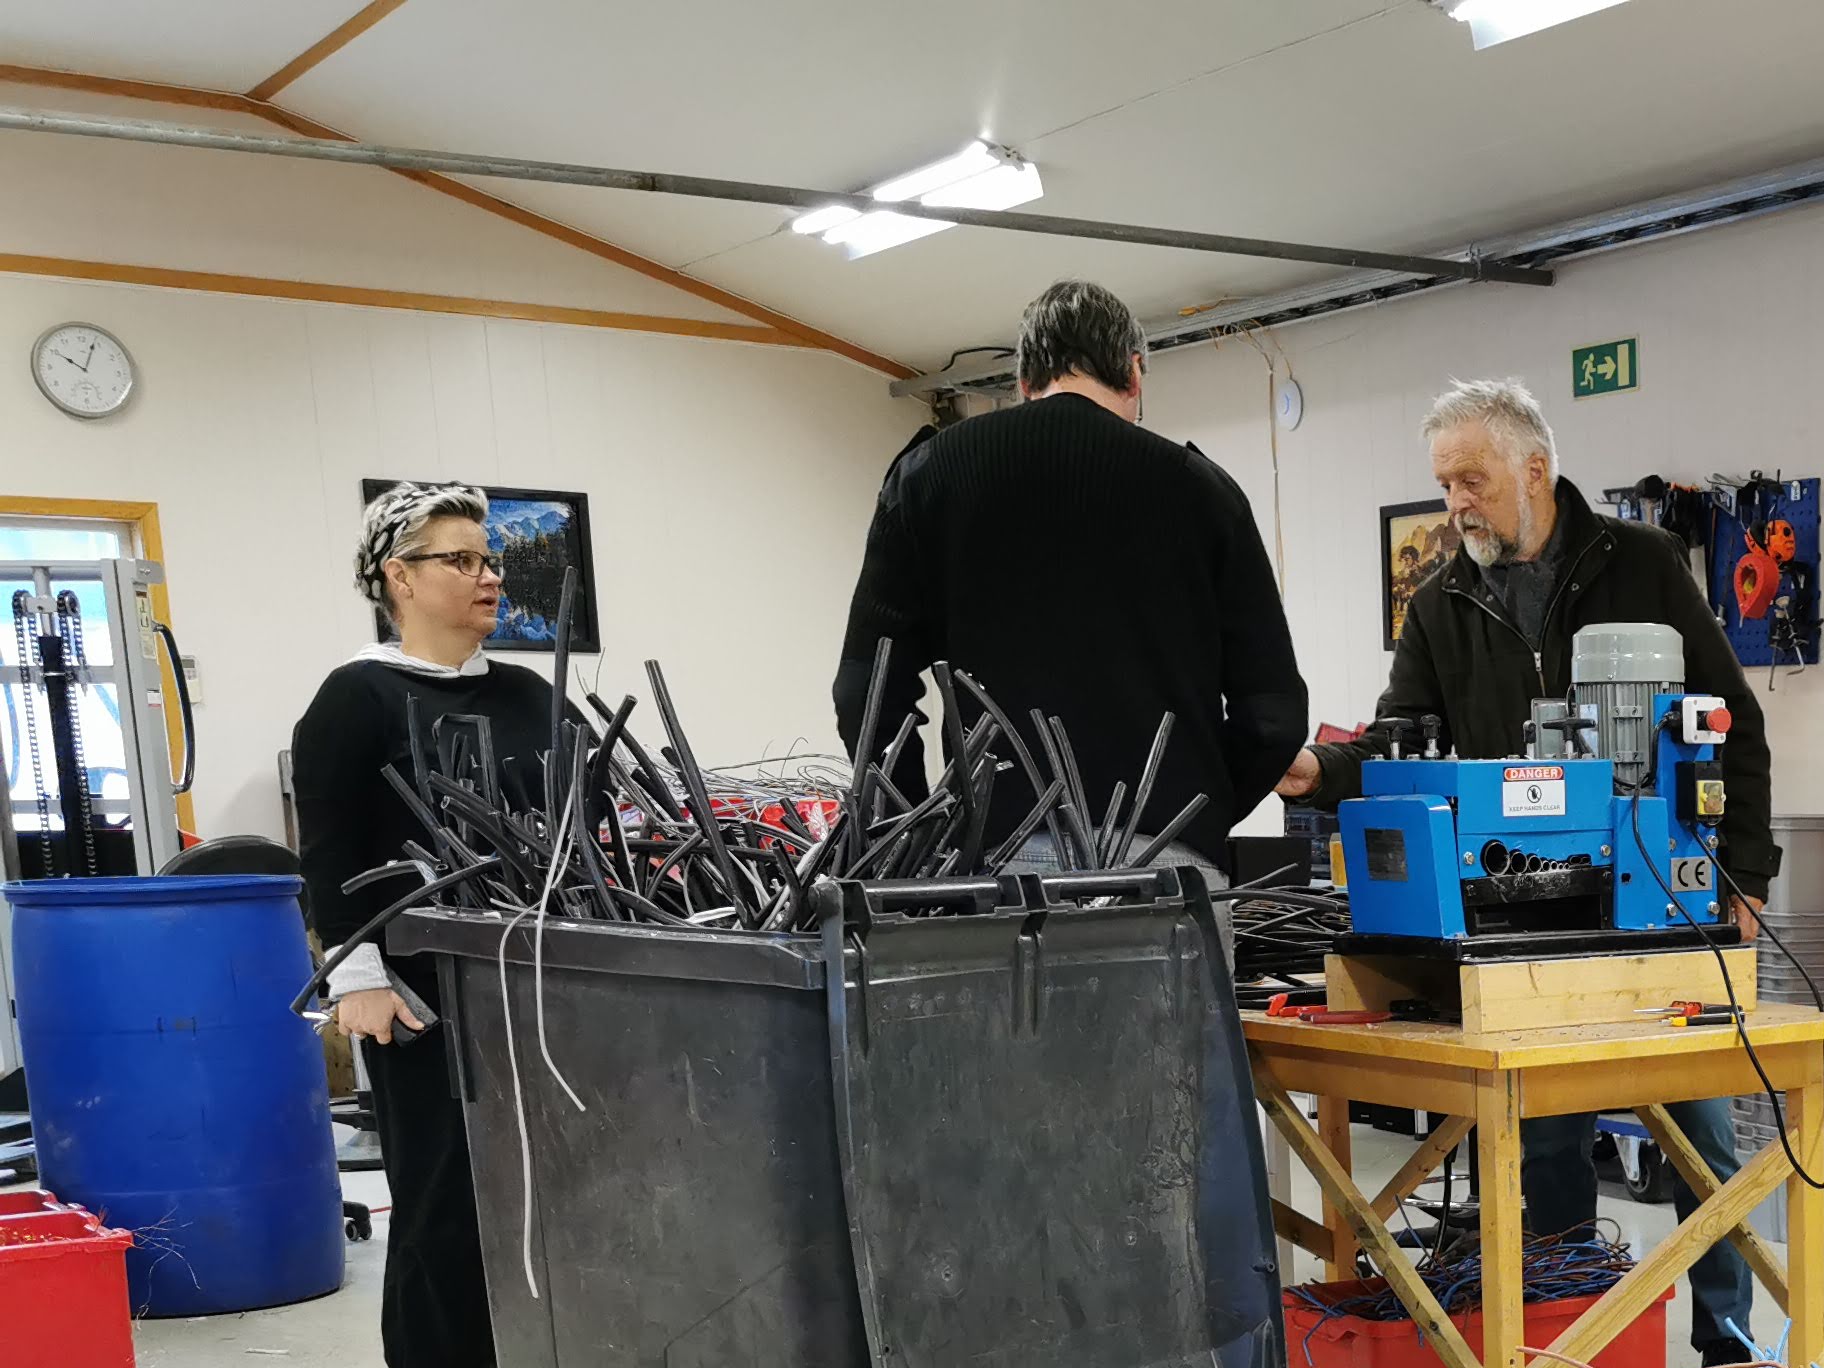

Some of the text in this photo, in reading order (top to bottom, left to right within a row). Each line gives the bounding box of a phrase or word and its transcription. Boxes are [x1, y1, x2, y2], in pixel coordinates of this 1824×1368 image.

[1510, 767, 1559, 779] DANGER
[1543, 803, 1561, 811] CLEAR
[1677, 860, 1706, 887] CE
